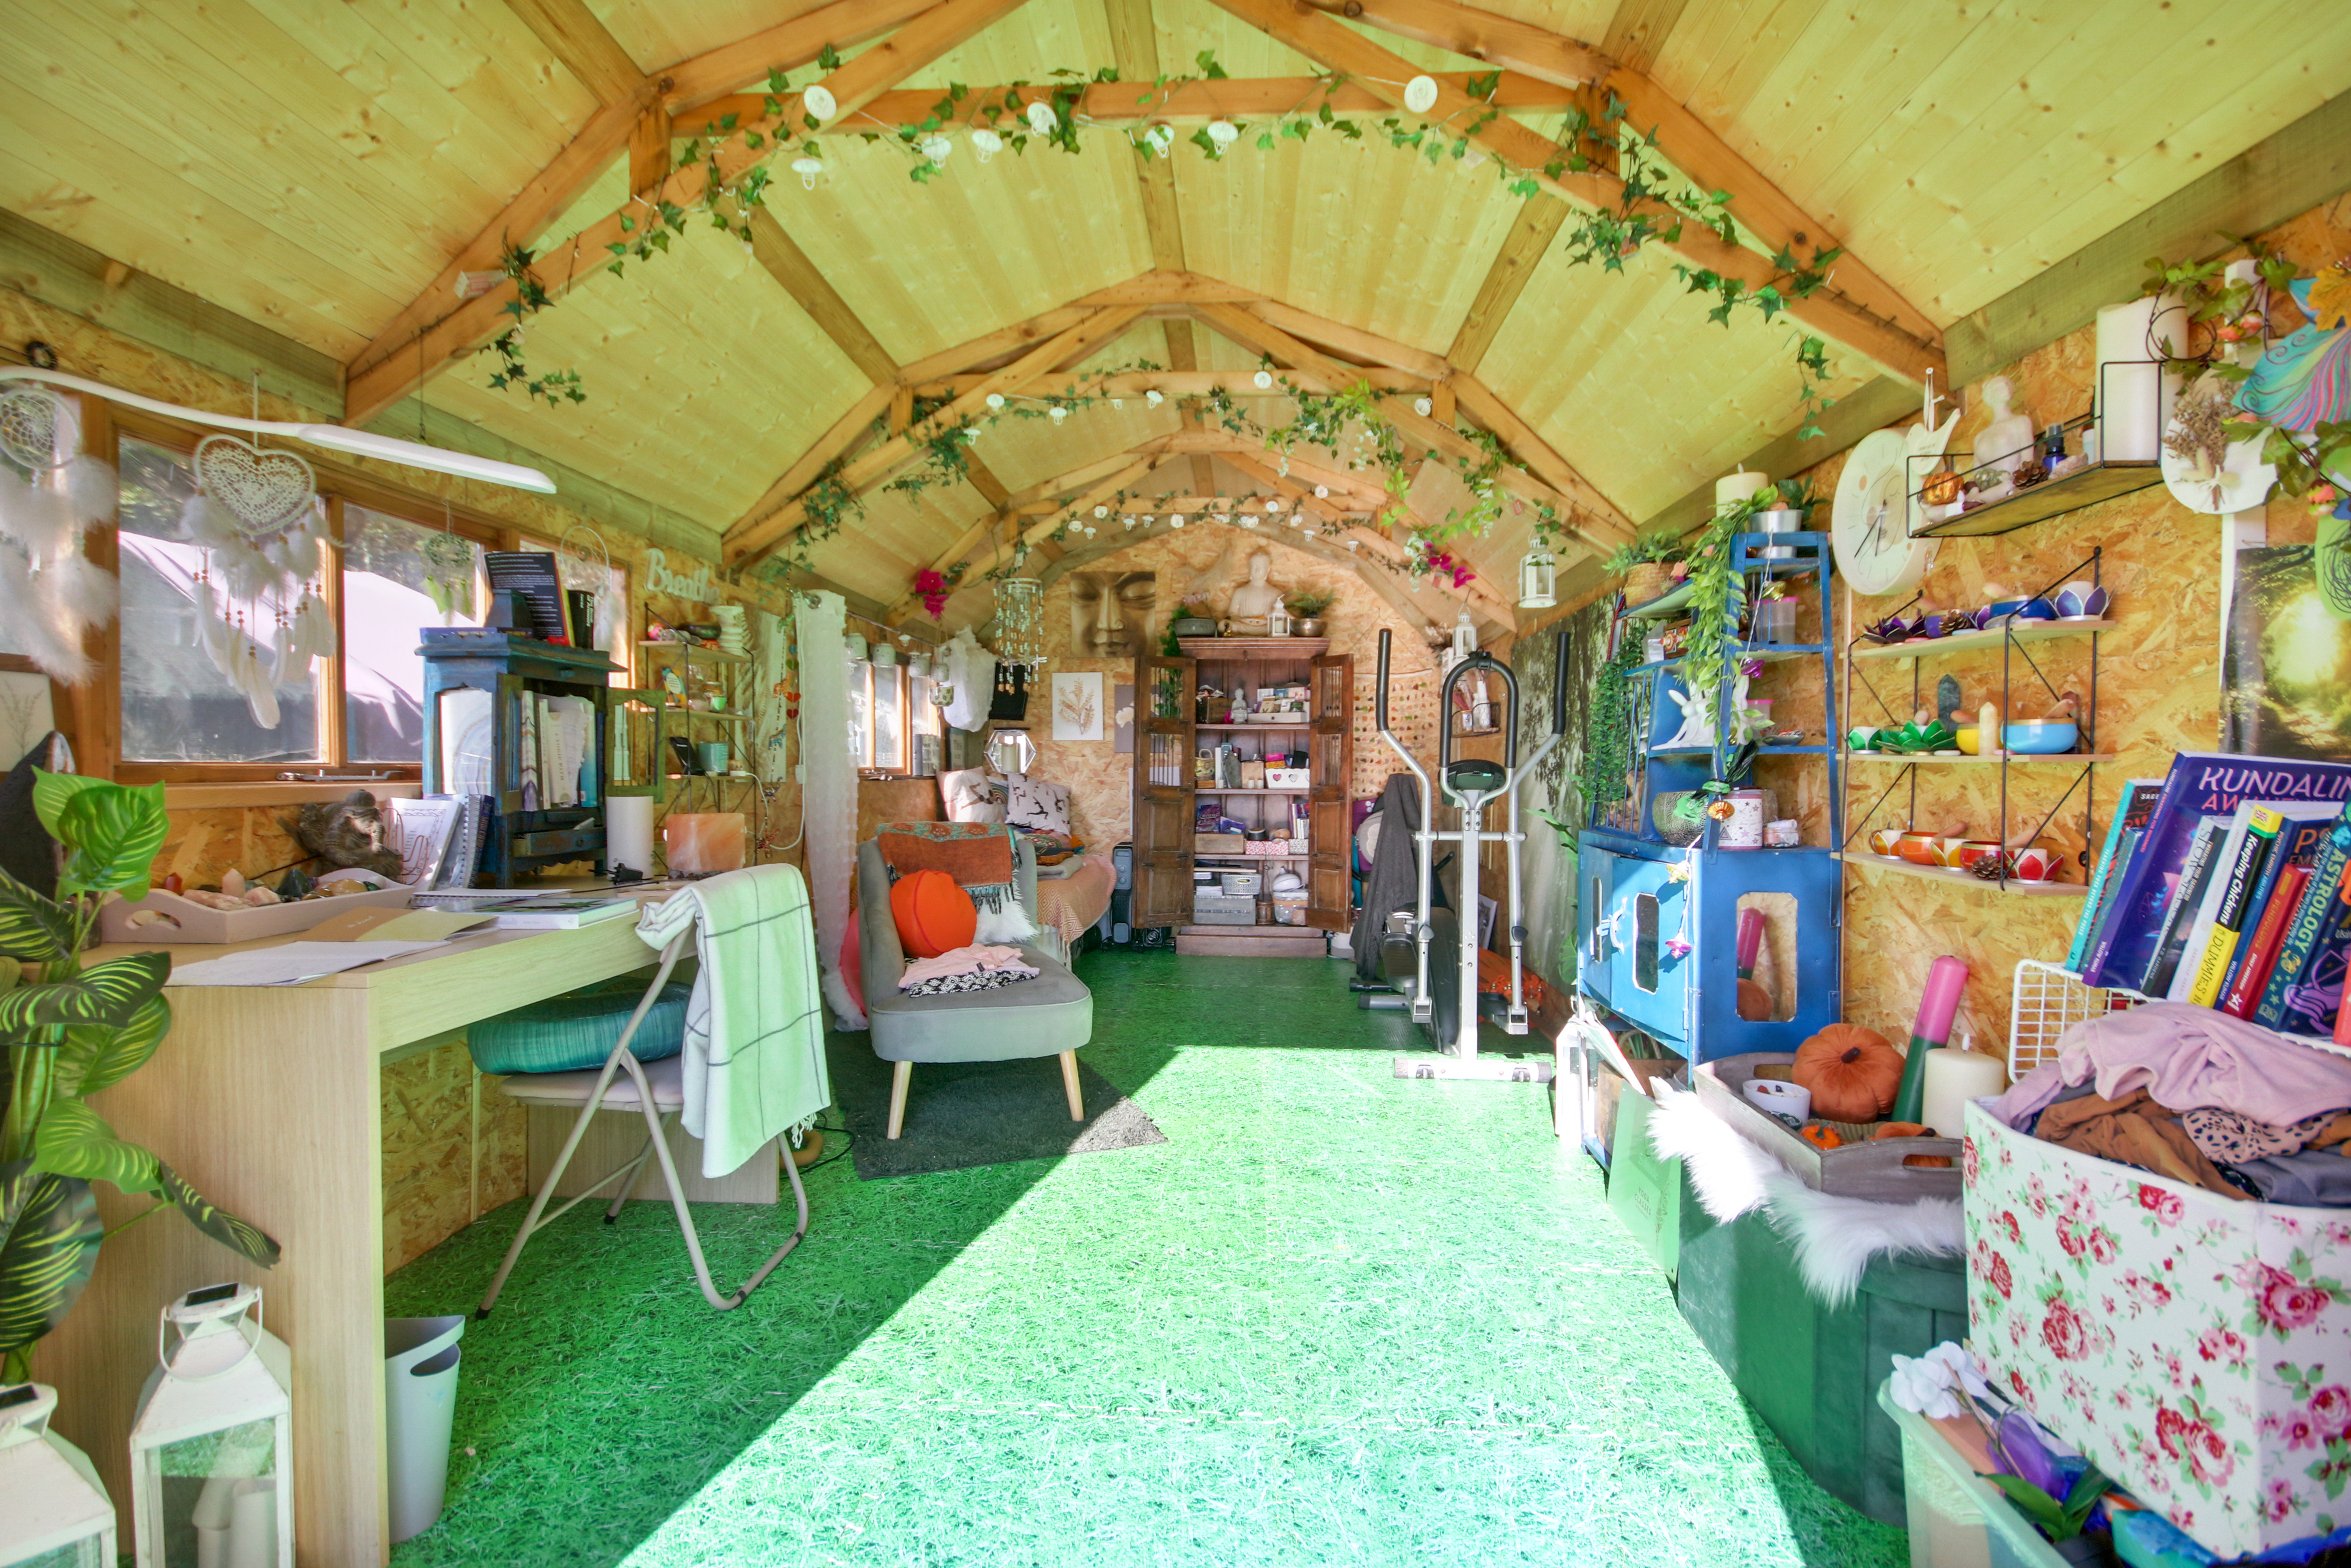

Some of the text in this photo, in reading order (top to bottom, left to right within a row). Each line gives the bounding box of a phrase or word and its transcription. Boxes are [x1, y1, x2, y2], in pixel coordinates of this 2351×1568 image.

[644, 548, 722, 605] Breathe
[2164, 768, 2177, 793] KUNDALINI
[2153, 792, 2167, 820] AWAKENING
[2139, 828, 2152, 853] BEGINNERS
[2098, 848, 2109, 874] TEACHING
[2183, 840, 2213, 902] EMBRACING YOUR DARKNESS
[2254, 830, 2284, 900] PSYCHIC EMPATH ABILITIES
[2218, 833, 2259, 926] Keeping Chickens
[2087, 888, 2097, 909] BEYOND
[2293, 846, 2347, 956] ASTROLOGY
[2078, 919, 2087, 935] POSES
[2254, 898, 2280, 950] PENDULUMS
[2090, 940, 2106, 973] WILLOW KUMAR
[2194, 935, 2225, 994] DUMMIES
[2238, 952, 2257, 991] EMILY ANDERSON
[2218, 960, 2237, 1000] WILLOW KUMAR
[1634, 1193, 1651, 1215] CLASSES
[1638, 1187, 1649, 1202] YOGA
